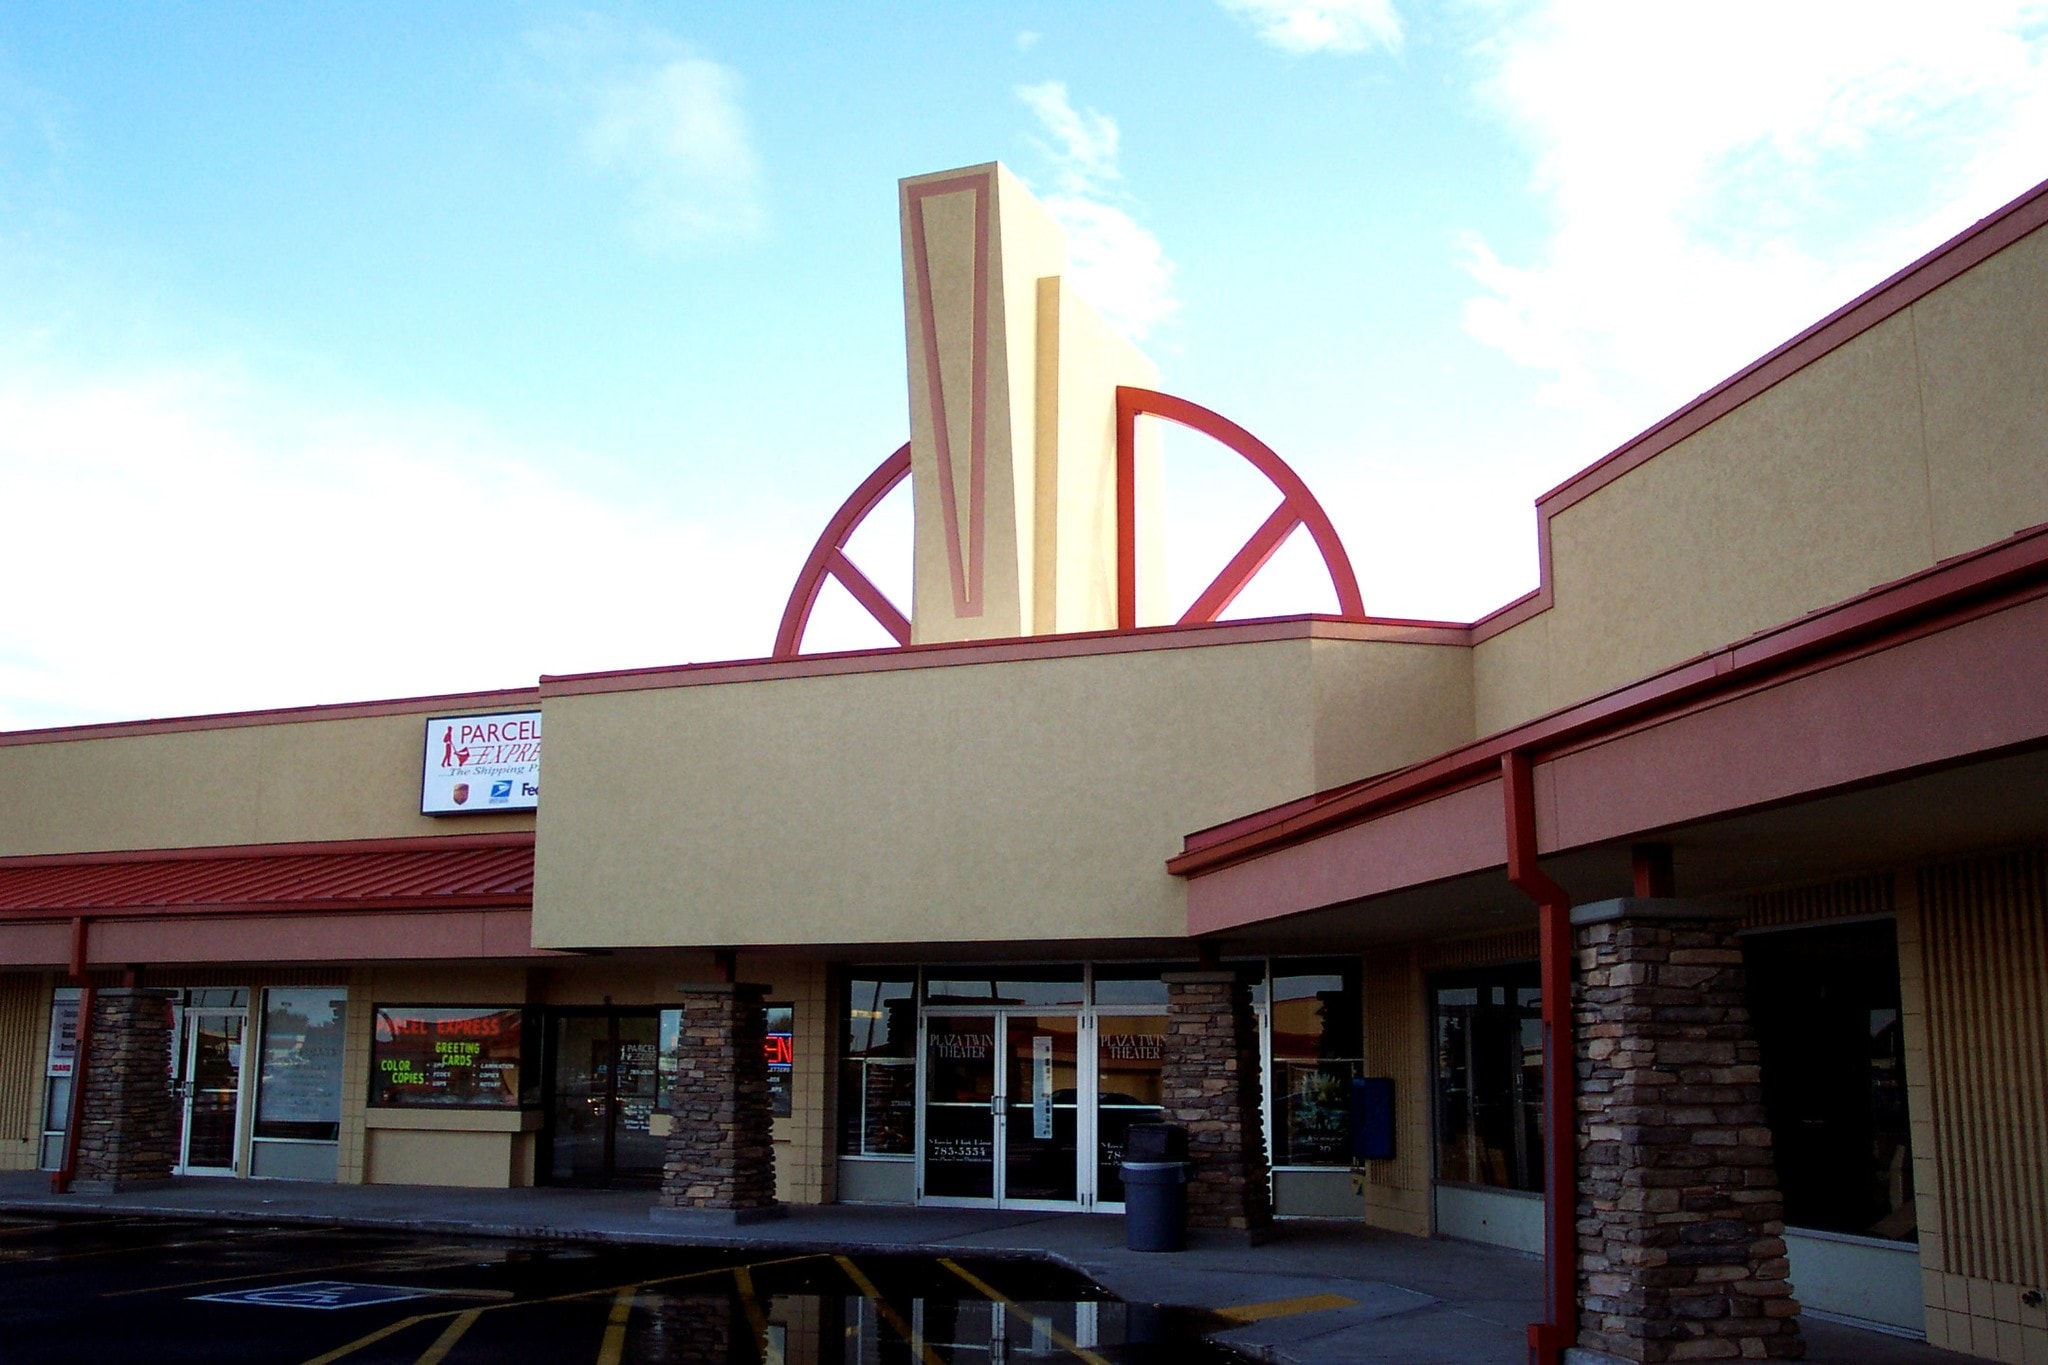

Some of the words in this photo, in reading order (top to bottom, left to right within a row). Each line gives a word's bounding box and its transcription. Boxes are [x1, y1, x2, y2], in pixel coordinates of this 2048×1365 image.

[461, 720, 541, 744] PARCEL
[450, 768, 470, 776] The
[473, 763, 525, 777] Shipping
[377, 1017, 428, 1036] PARCEL
[436, 1018, 500, 1036] EXPRESS
[930, 1034, 962, 1047] PLAZA
[964, 1034, 994, 1047] TWIN
[1100, 1034, 1136, 1047] PLAZA
[435, 1042, 481, 1054] GREETING
[939, 1046, 985, 1058] THEATER
[1110, 1046, 1160, 1059] THEATER
[381, 1060, 411, 1072] COLOR
[441, 1054, 473, 1067] CARDS
[392, 1073, 424, 1084] COPIES
[974, 1138, 992, 1146] Line
[1101, 1141, 1124, 1149] Movi
